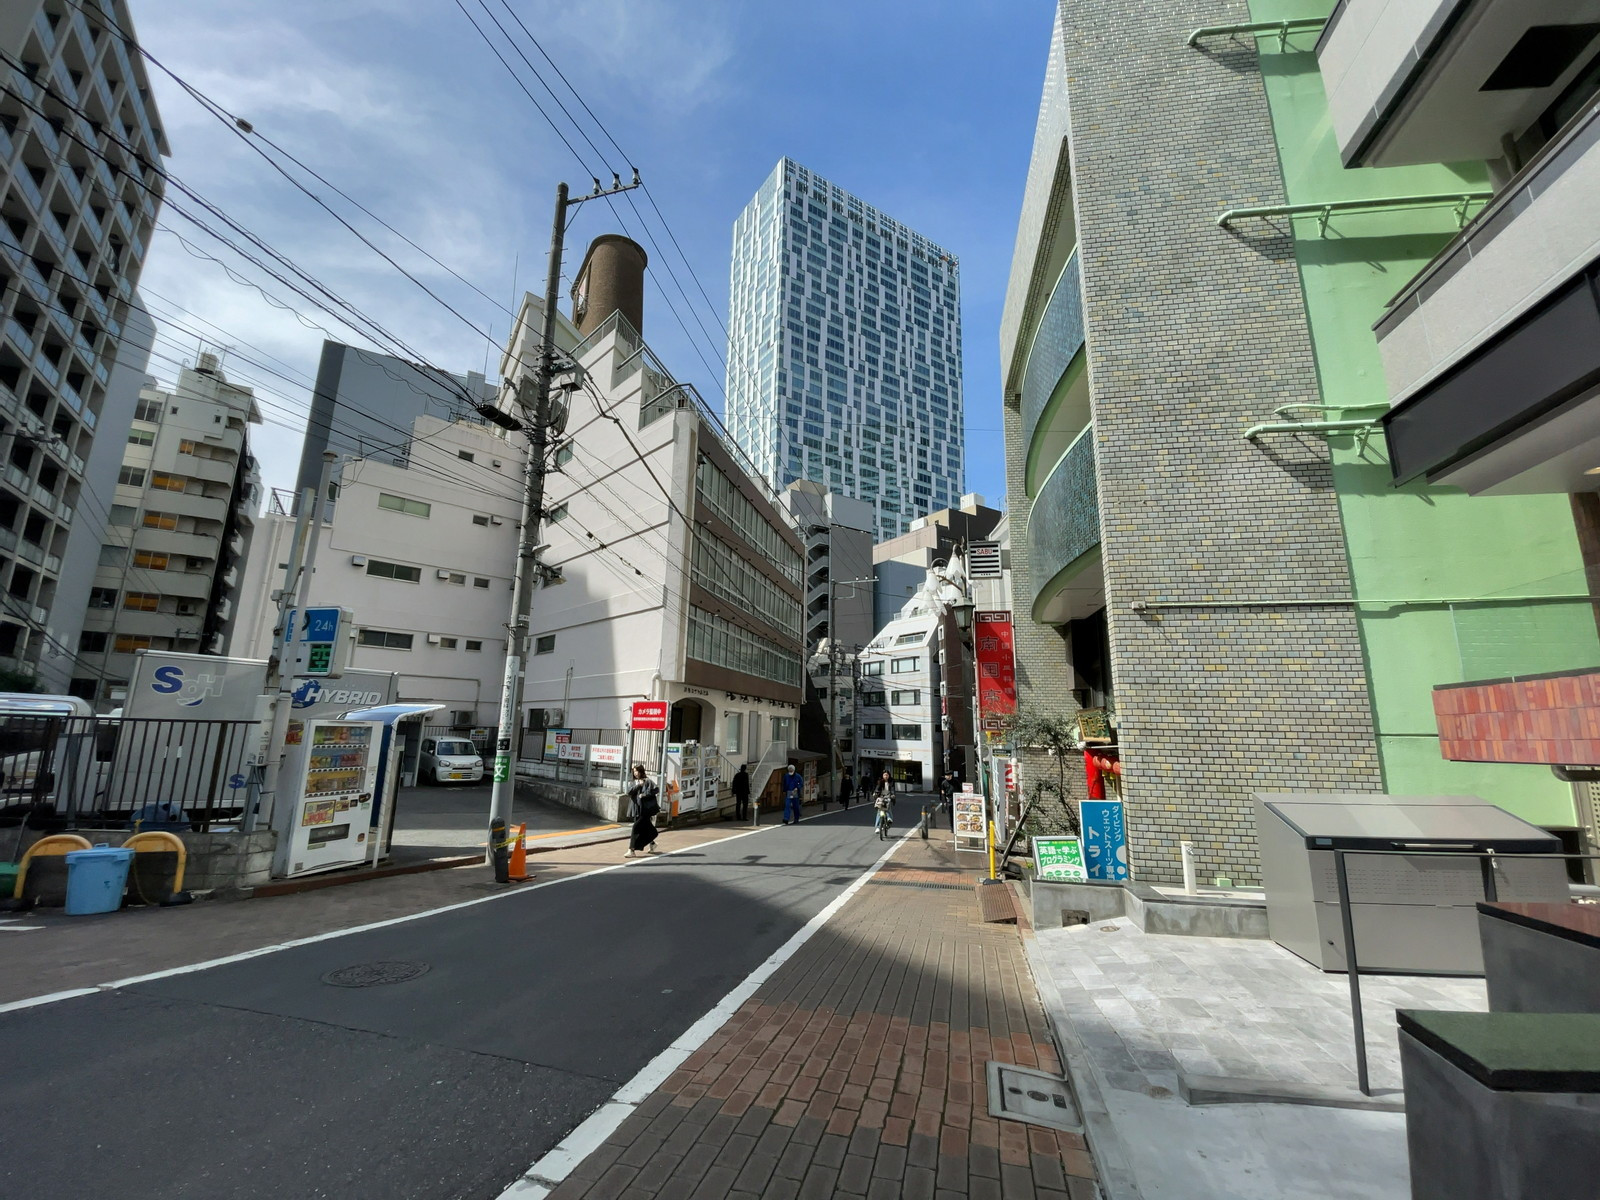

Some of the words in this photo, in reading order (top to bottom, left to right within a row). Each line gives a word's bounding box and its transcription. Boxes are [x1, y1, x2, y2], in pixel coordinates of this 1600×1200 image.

[314, 619, 334, 632] 24h
[304, 687, 382, 705] HYBRID
[494, 764, 507, 778] 文
[1112, 805, 1122, 842] ダイビング
[1038, 846, 1078, 855] 英語で学ぶ
[1088, 826, 1101, 877] トライ
[1040, 855, 1080, 866] プログラミング
